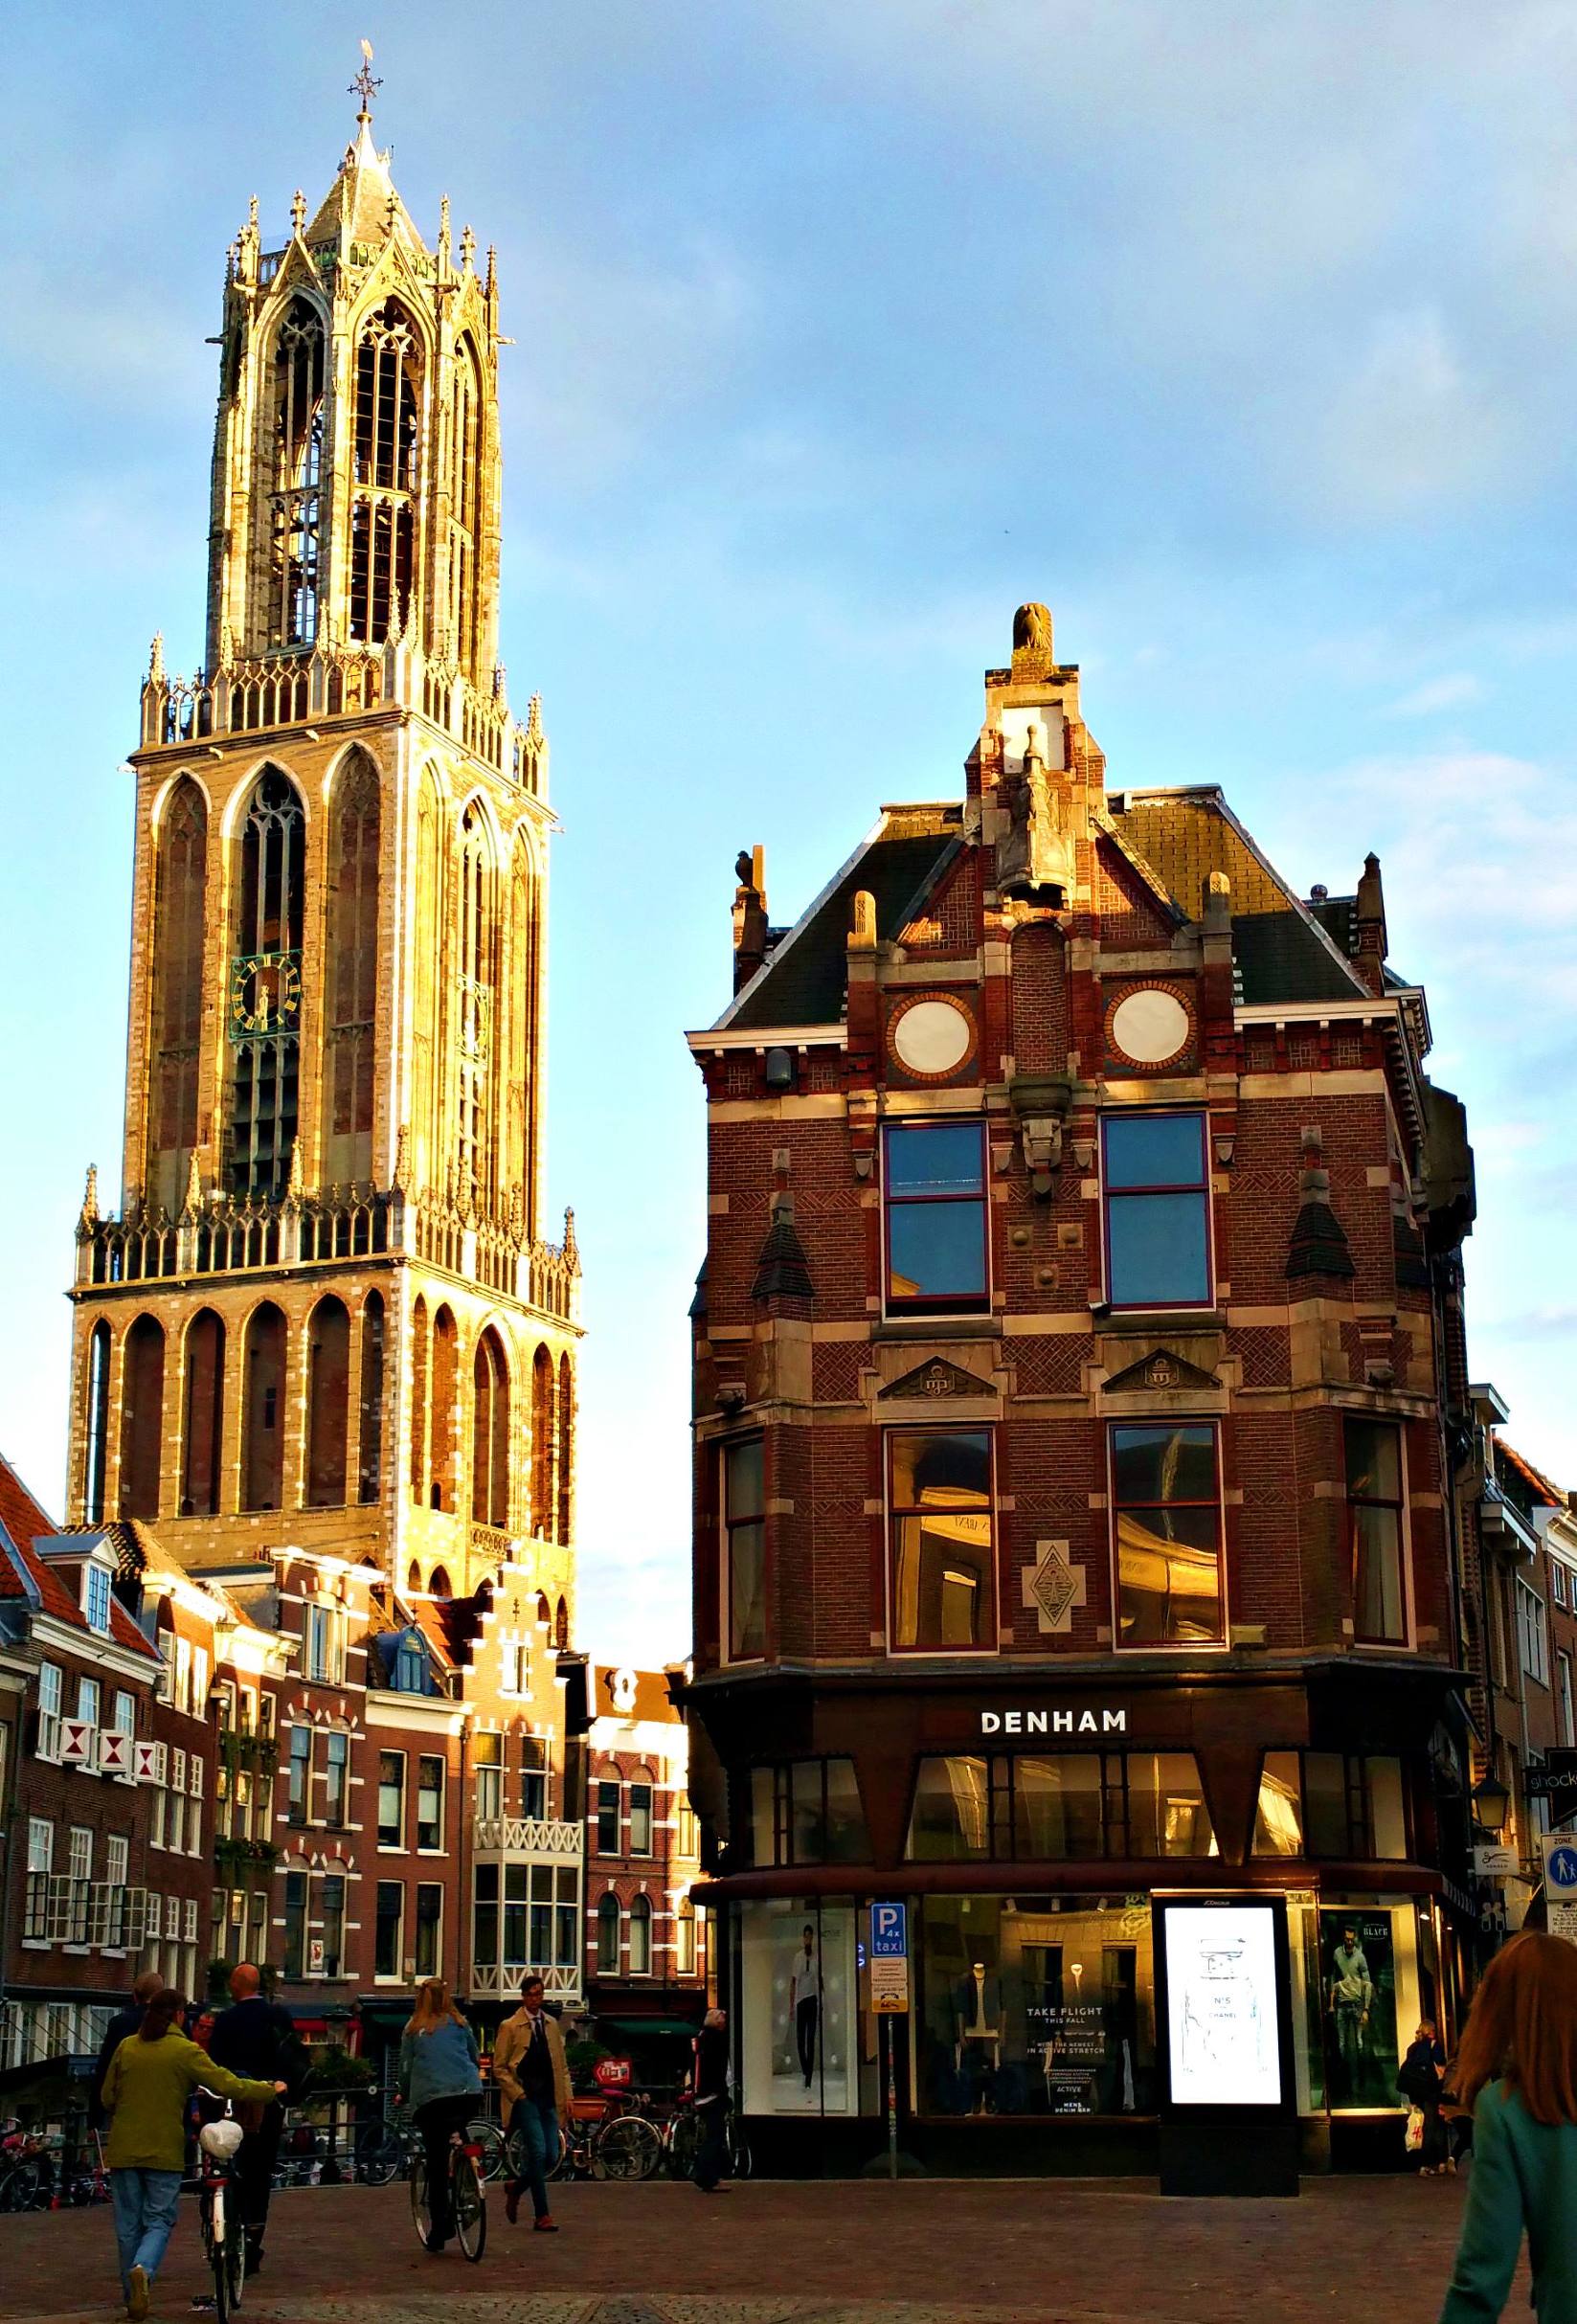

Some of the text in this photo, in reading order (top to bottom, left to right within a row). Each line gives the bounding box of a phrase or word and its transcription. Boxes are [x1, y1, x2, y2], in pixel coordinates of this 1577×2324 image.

[981, 1710, 1126, 1733] DENHAM
[879, 1908, 898, 1934] P
[876, 1940, 902, 1952] taxi
[1061, 2007, 1102, 2016] FLIGHT
